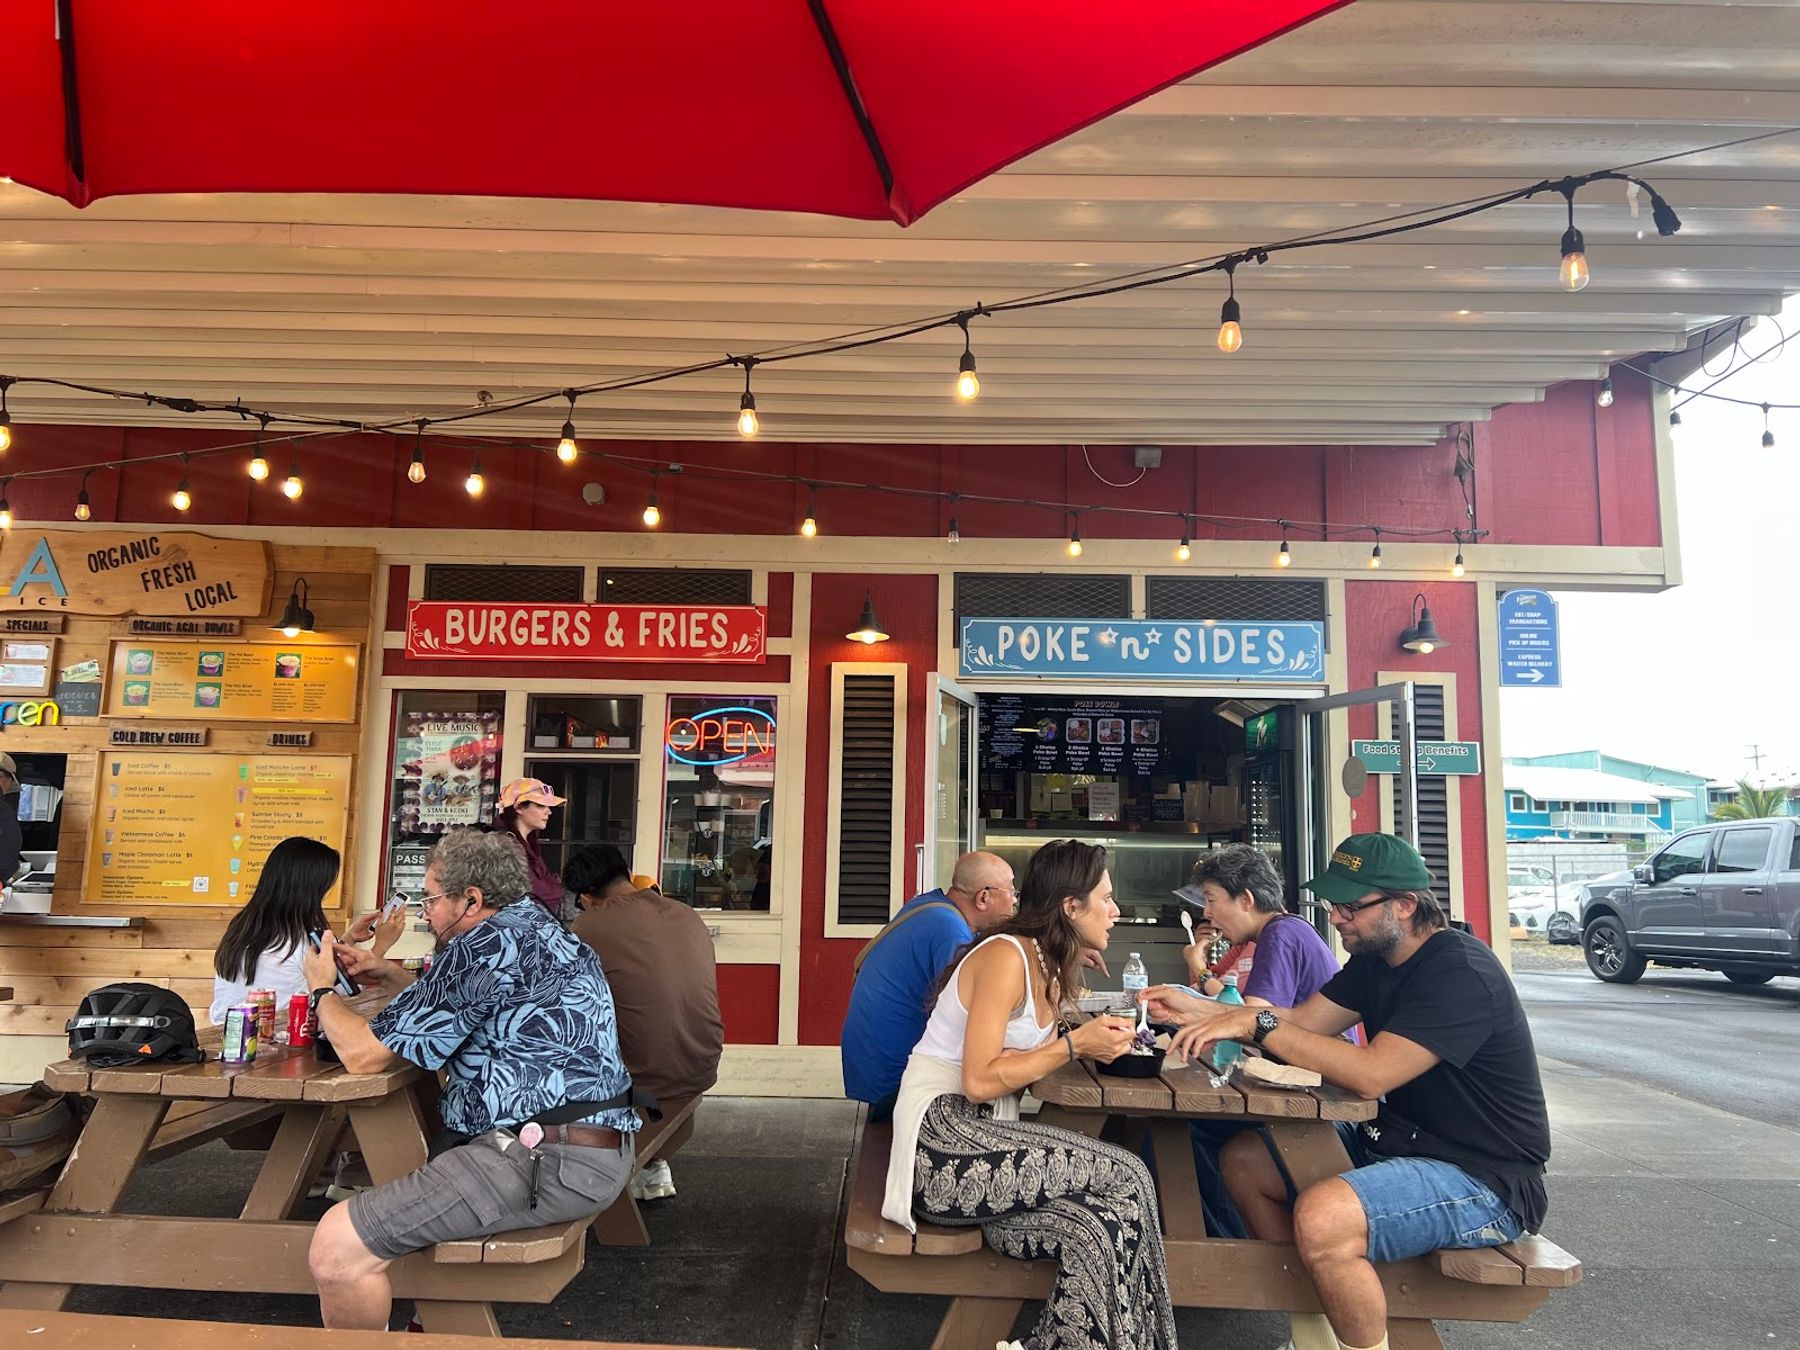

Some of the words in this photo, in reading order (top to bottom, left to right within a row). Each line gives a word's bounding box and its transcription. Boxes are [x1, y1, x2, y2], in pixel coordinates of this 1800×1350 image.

[87, 536, 161, 573] ORGANIC
[9, 536, 68, 596] A
[141, 560, 196, 592] FRESH
[20, 597, 68, 606] ICE
[185, 581, 238, 611] LOCAL
[6, 619, 48, 631] SPECIALS
[133, 619, 173, 632] ORGANIC
[176, 621, 198, 633] ACAI
[205, 622, 234, 634] BOWLS
[445, 609, 591, 647] BURGERS
[604, 611, 624, 647] &
[639, 611, 729, 648] FRIES
[998, 625, 1090, 662] POKE
[1121, 636, 1149, 661] n
[1173, 627, 1285, 664] SIDES
[427, 724, 448, 732] LIVE
[451, 723, 481, 732] MUSIC
[113, 731, 137, 743] COLD
[140, 731, 165, 743] BREW
[168, 732, 200, 743] COFFEE
[272, 733, 307, 745] DRINKS
[668, 718, 771, 754] OPEN
[1363, 744, 1387, 754] Food
[1390, 745, 1424, 757] Stp
[1425, 746, 1469, 756] Benefits
[396, 854, 426, 864] PASS
